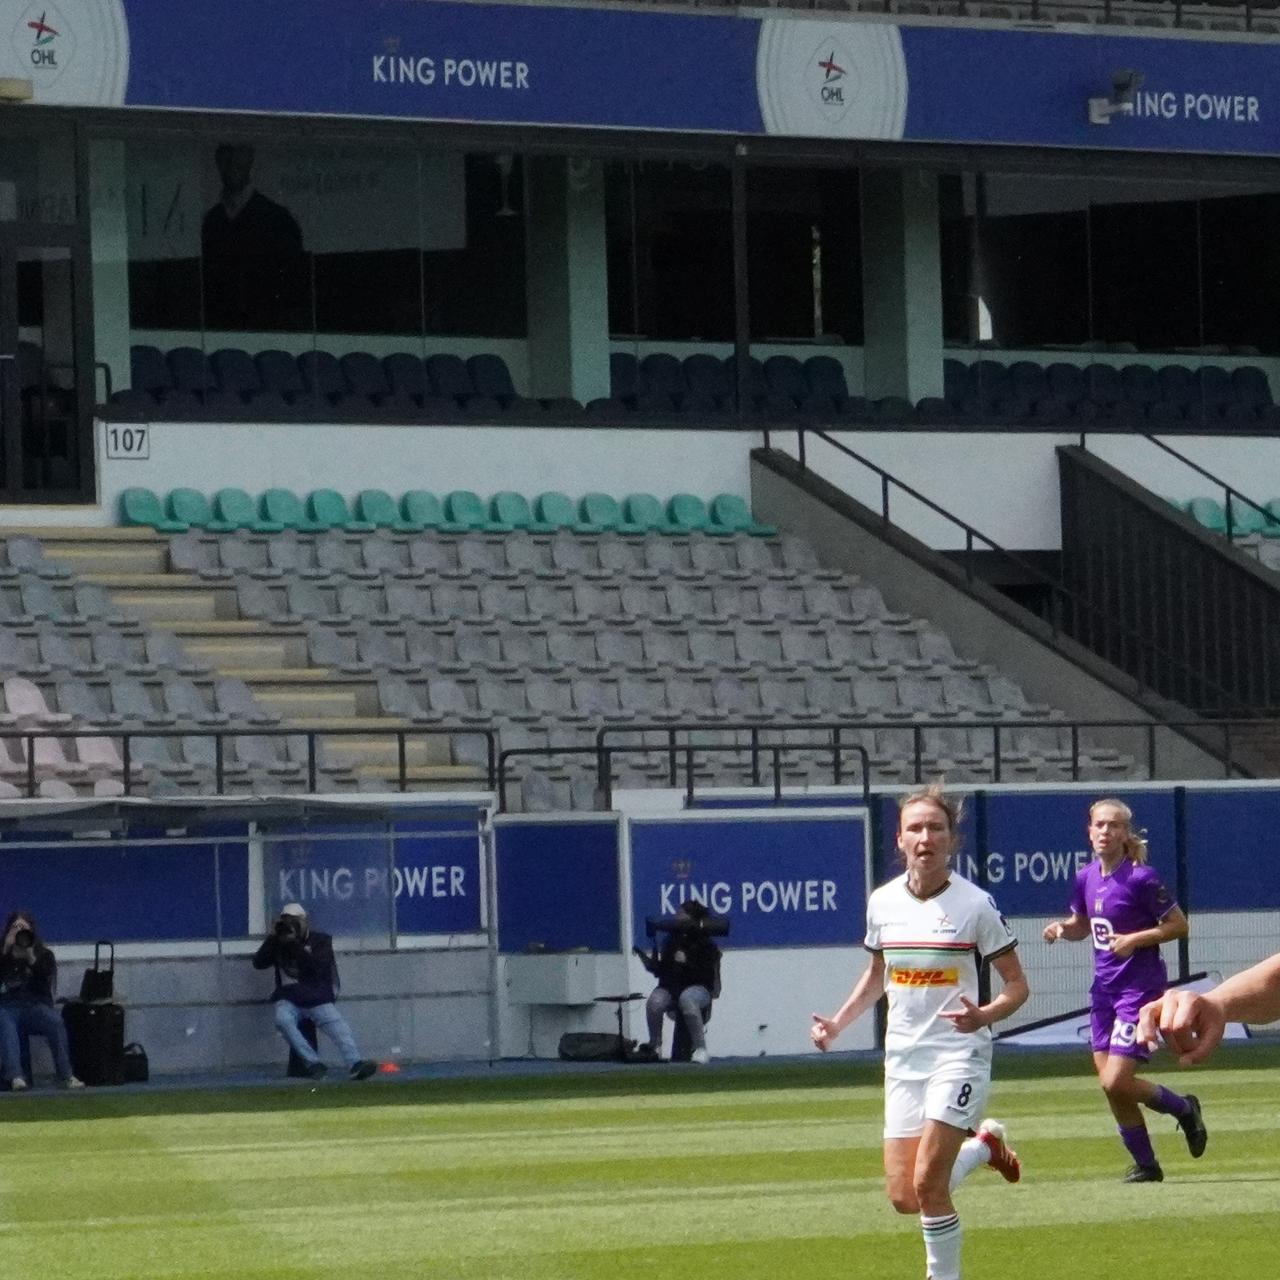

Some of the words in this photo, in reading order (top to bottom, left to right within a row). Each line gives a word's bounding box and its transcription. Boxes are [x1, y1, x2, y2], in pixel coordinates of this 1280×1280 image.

[31, 49, 57, 65] OHL
[373, 55, 436, 86] KING
[443, 59, 529, 89] POWER
[1124, 91, 1178, 119] ING
[1184, 93, 1260, 122] POWER
[110, 428, 146, 451] 107
[953, 852, 1005, 884] ING
[1014, 851, 1097, 883] POWE
[279, 867, 354, 900] KING
[364, 866, 466, 898] POWER
[661, 881, 732, 915] KING
[742, 880, 838, 913] POWER
[894, 970, 958, 985] DHL
[1111, 1018, 1138, 1048] 29
[957, 1083, 972, 1107] 8
